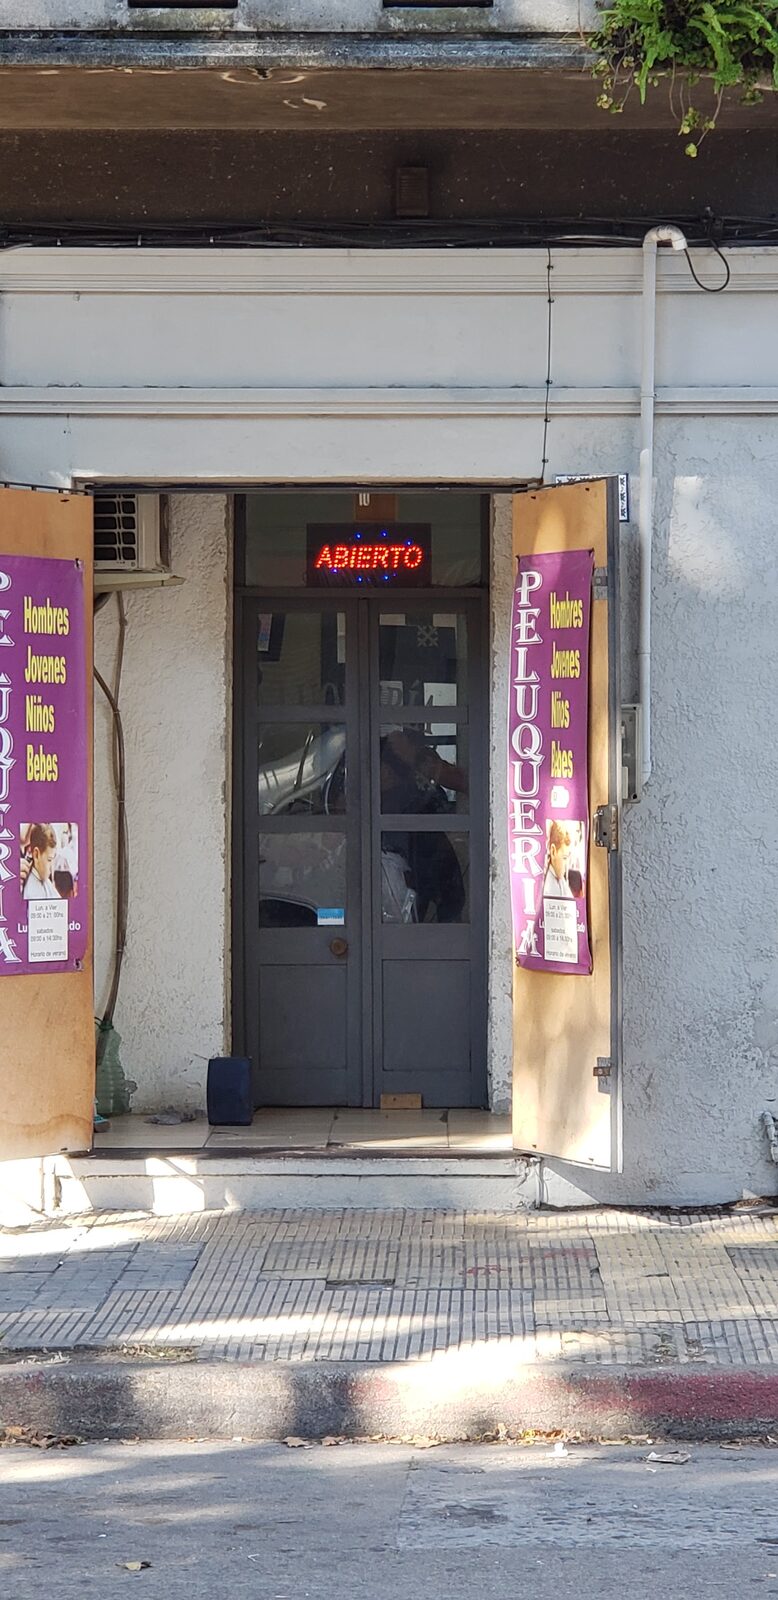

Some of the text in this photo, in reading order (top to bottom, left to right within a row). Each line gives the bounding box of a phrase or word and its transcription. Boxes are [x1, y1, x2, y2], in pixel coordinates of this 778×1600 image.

[314, 544, 423, 569] ABIERTO
[23, 596, 70, 635] Hombres
[550, 591, 584, 629] Hombres
[24, 645, 67, 684] Jovenes
[551, 641, 581, 679] Jovenes
[25, 695, 55, 733] Niños
[26, 744, 58, 782] Bebes
[509, 571, 545, 958] PELUQUERIA
